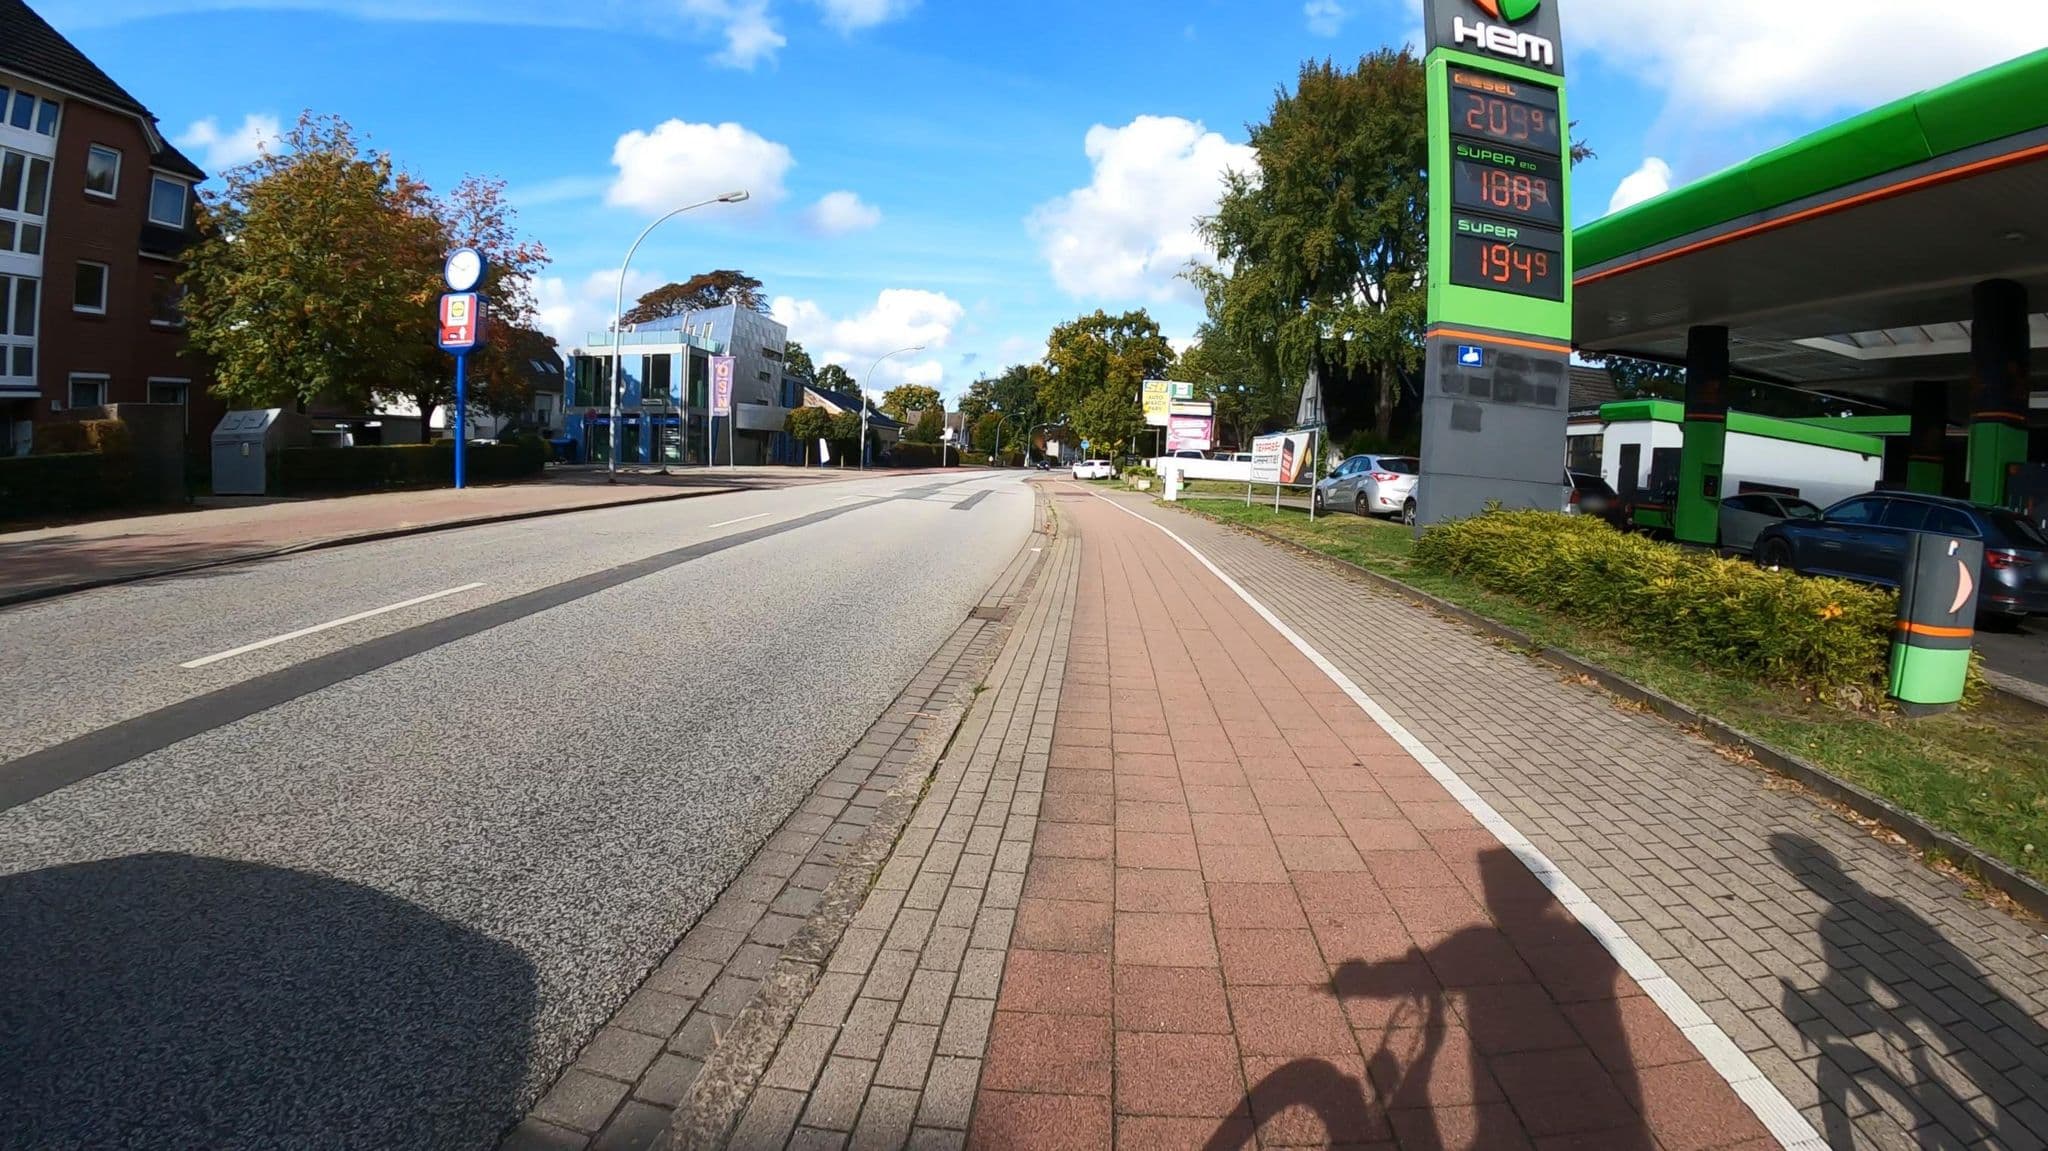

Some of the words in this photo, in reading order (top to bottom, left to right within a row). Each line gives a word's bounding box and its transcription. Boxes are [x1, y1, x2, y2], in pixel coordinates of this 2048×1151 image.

[1454, 72, 1516, 96] DIESEL
[1457, 144, 1516, 166] SUPER
[1457, 219, 1519, 239] SUPER
